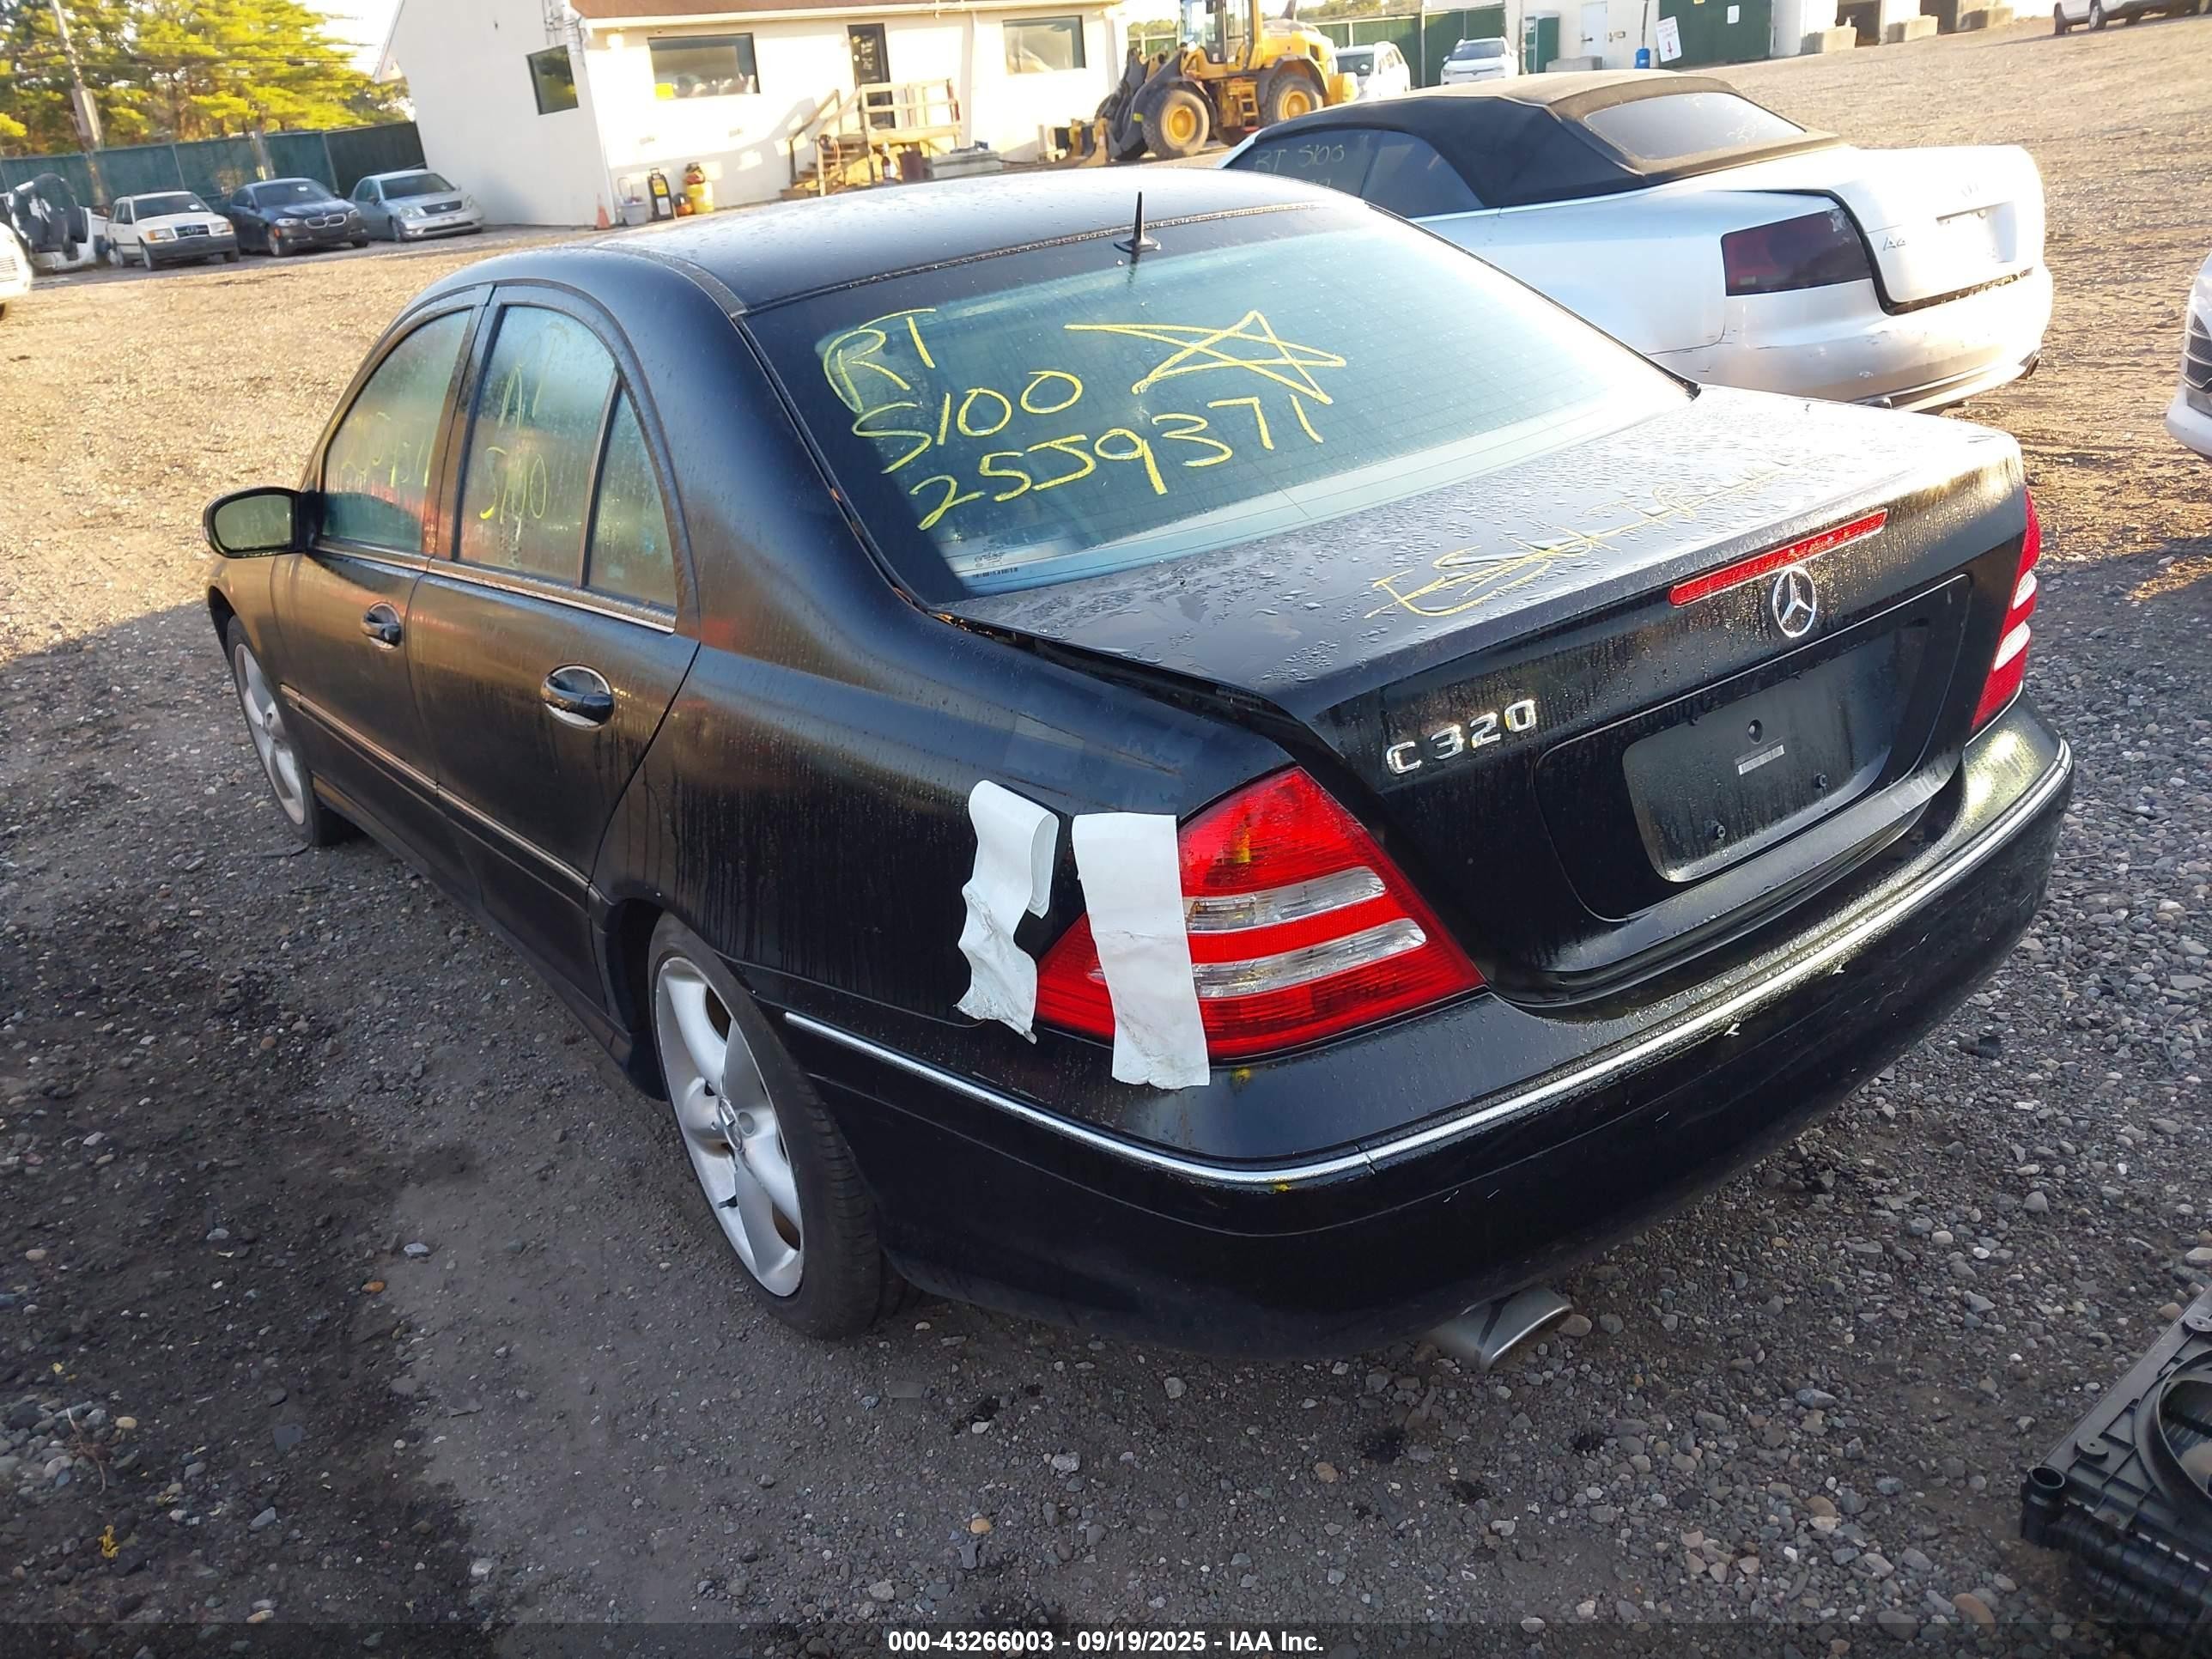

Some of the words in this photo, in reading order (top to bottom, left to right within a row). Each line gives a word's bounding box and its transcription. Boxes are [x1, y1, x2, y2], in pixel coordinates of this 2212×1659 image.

[823, 307, 937, 414] RT
[1386, 741, 1423, 775] C
[1430, 699, 1537, 761] 320
